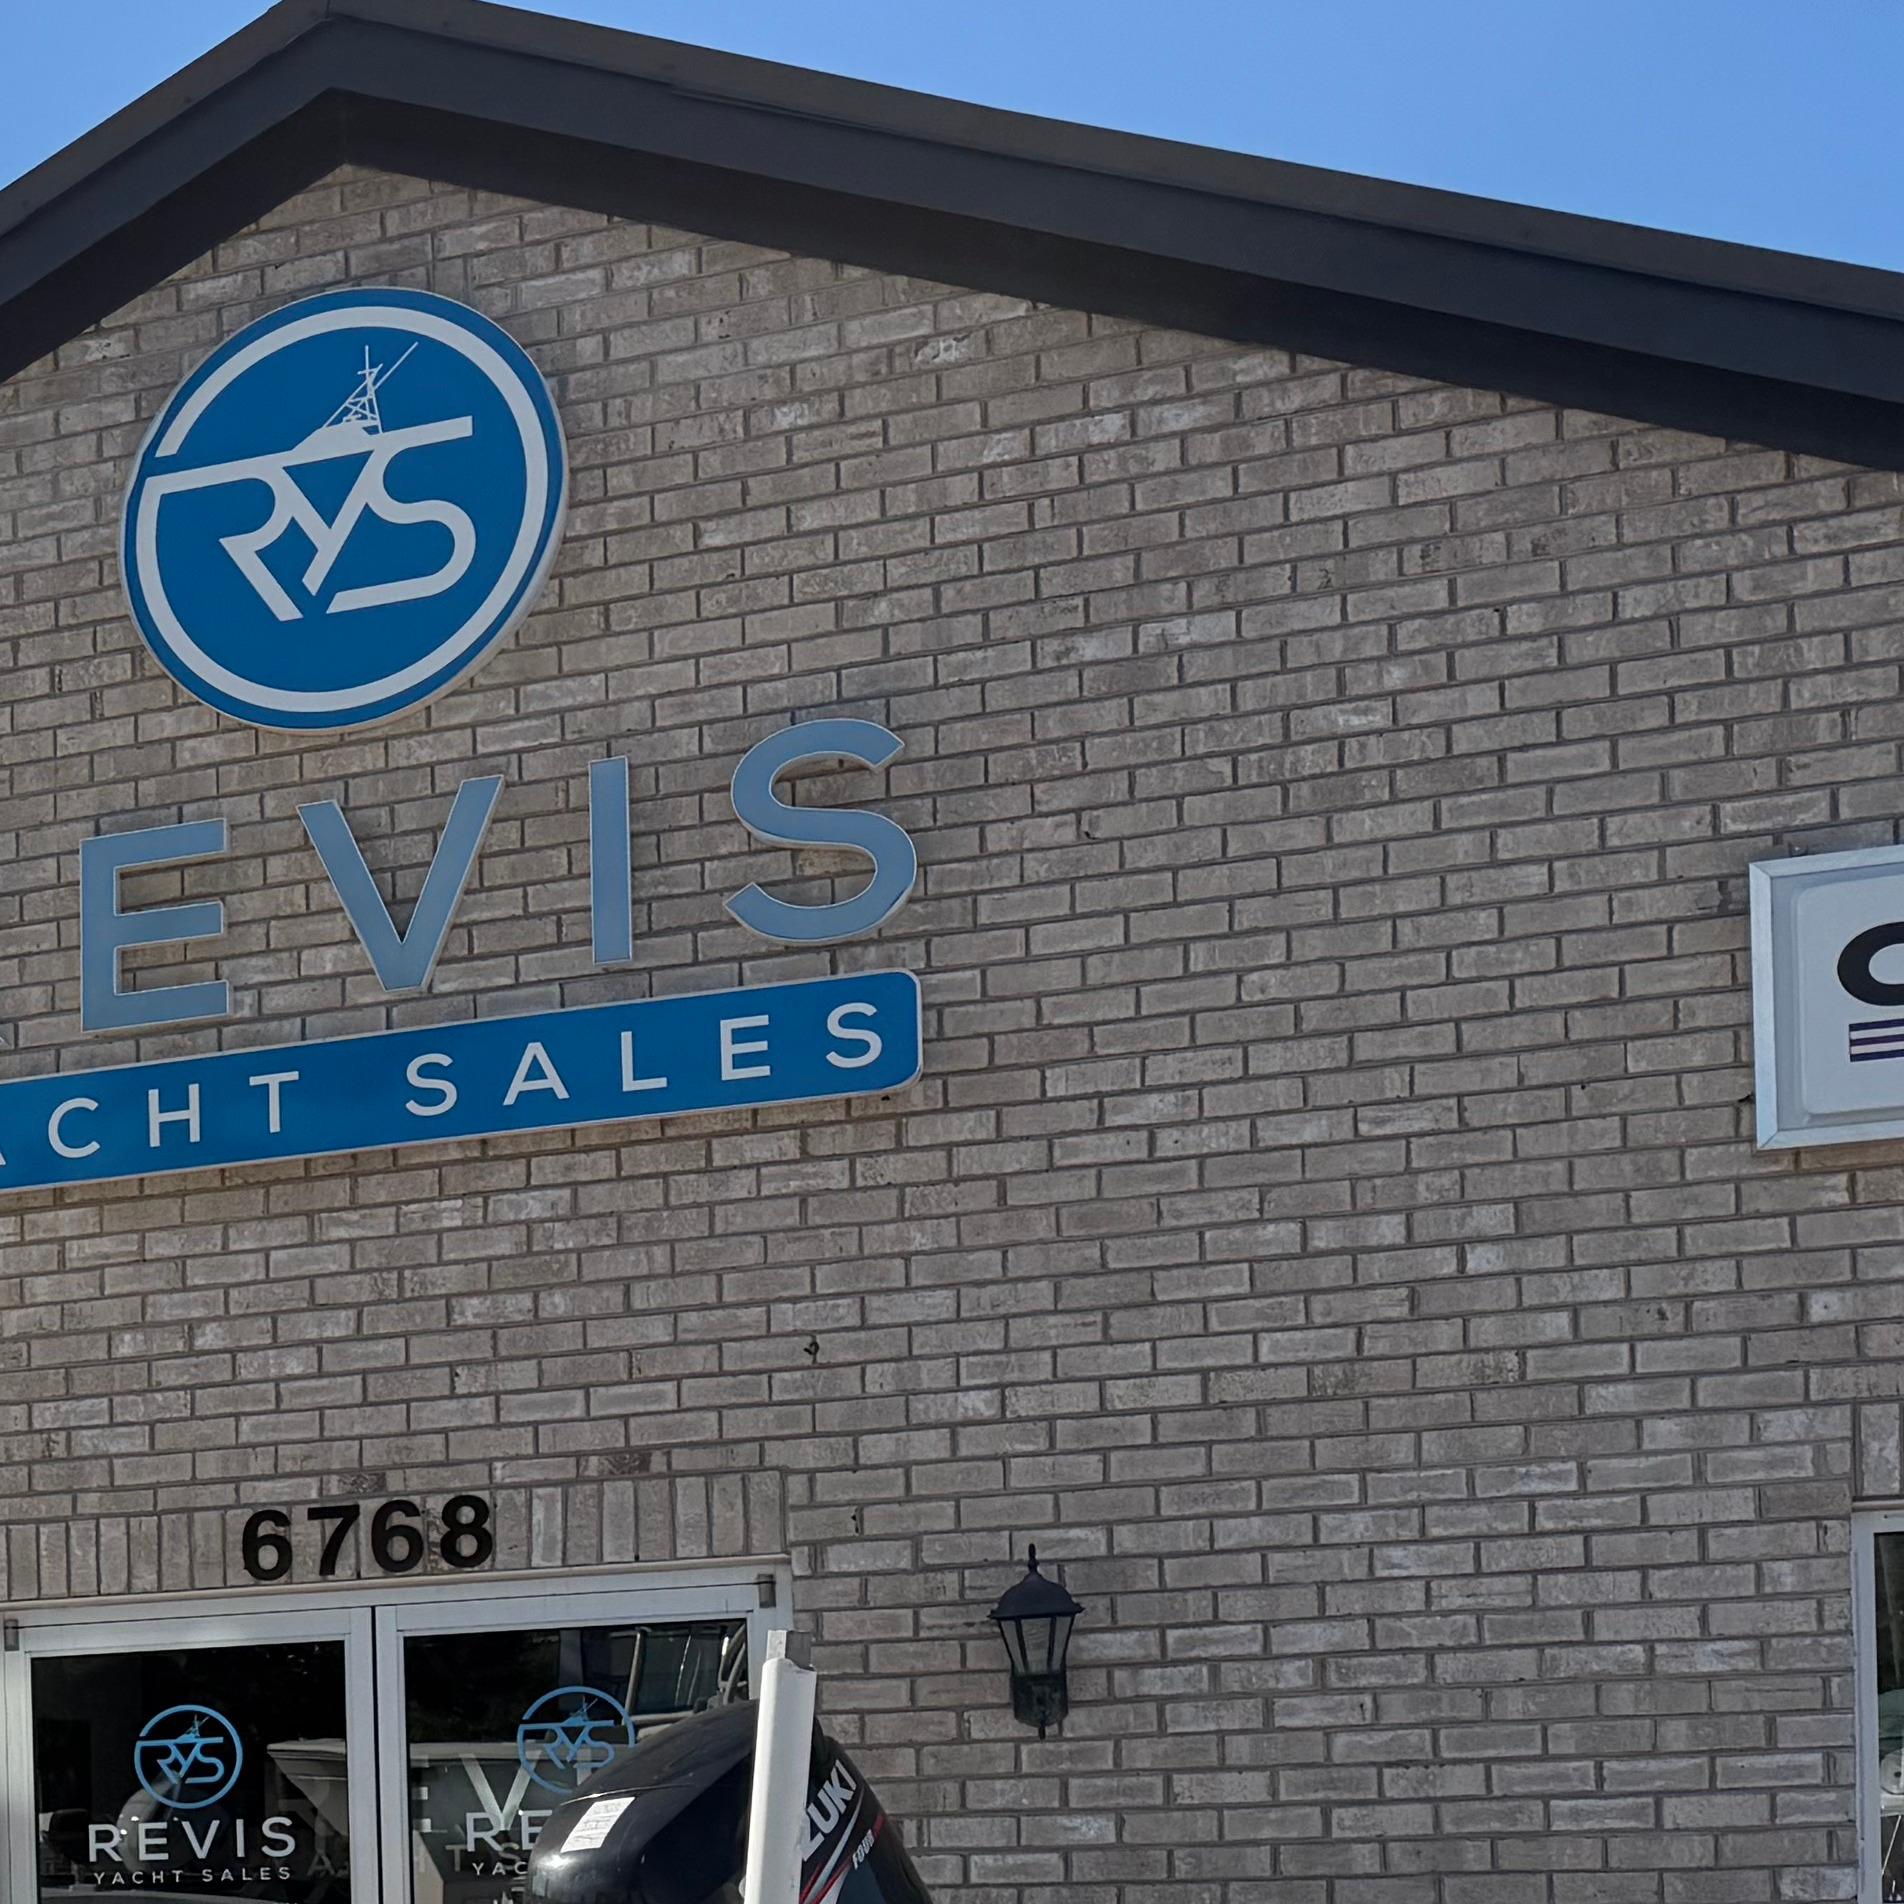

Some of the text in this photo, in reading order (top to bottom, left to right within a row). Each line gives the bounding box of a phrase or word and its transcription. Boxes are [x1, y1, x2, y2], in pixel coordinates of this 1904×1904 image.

[405, 1002, 882, 1116] SALES
[242, 1494, 492, 1581] 6768
[88, 1816, 296, 1862] REVIS
[799, 1759, 857, 1862] ZUKI
[94, 1866, 291, 1885] YACHT SALES
[472, 1862, 528, 1876] YAC
